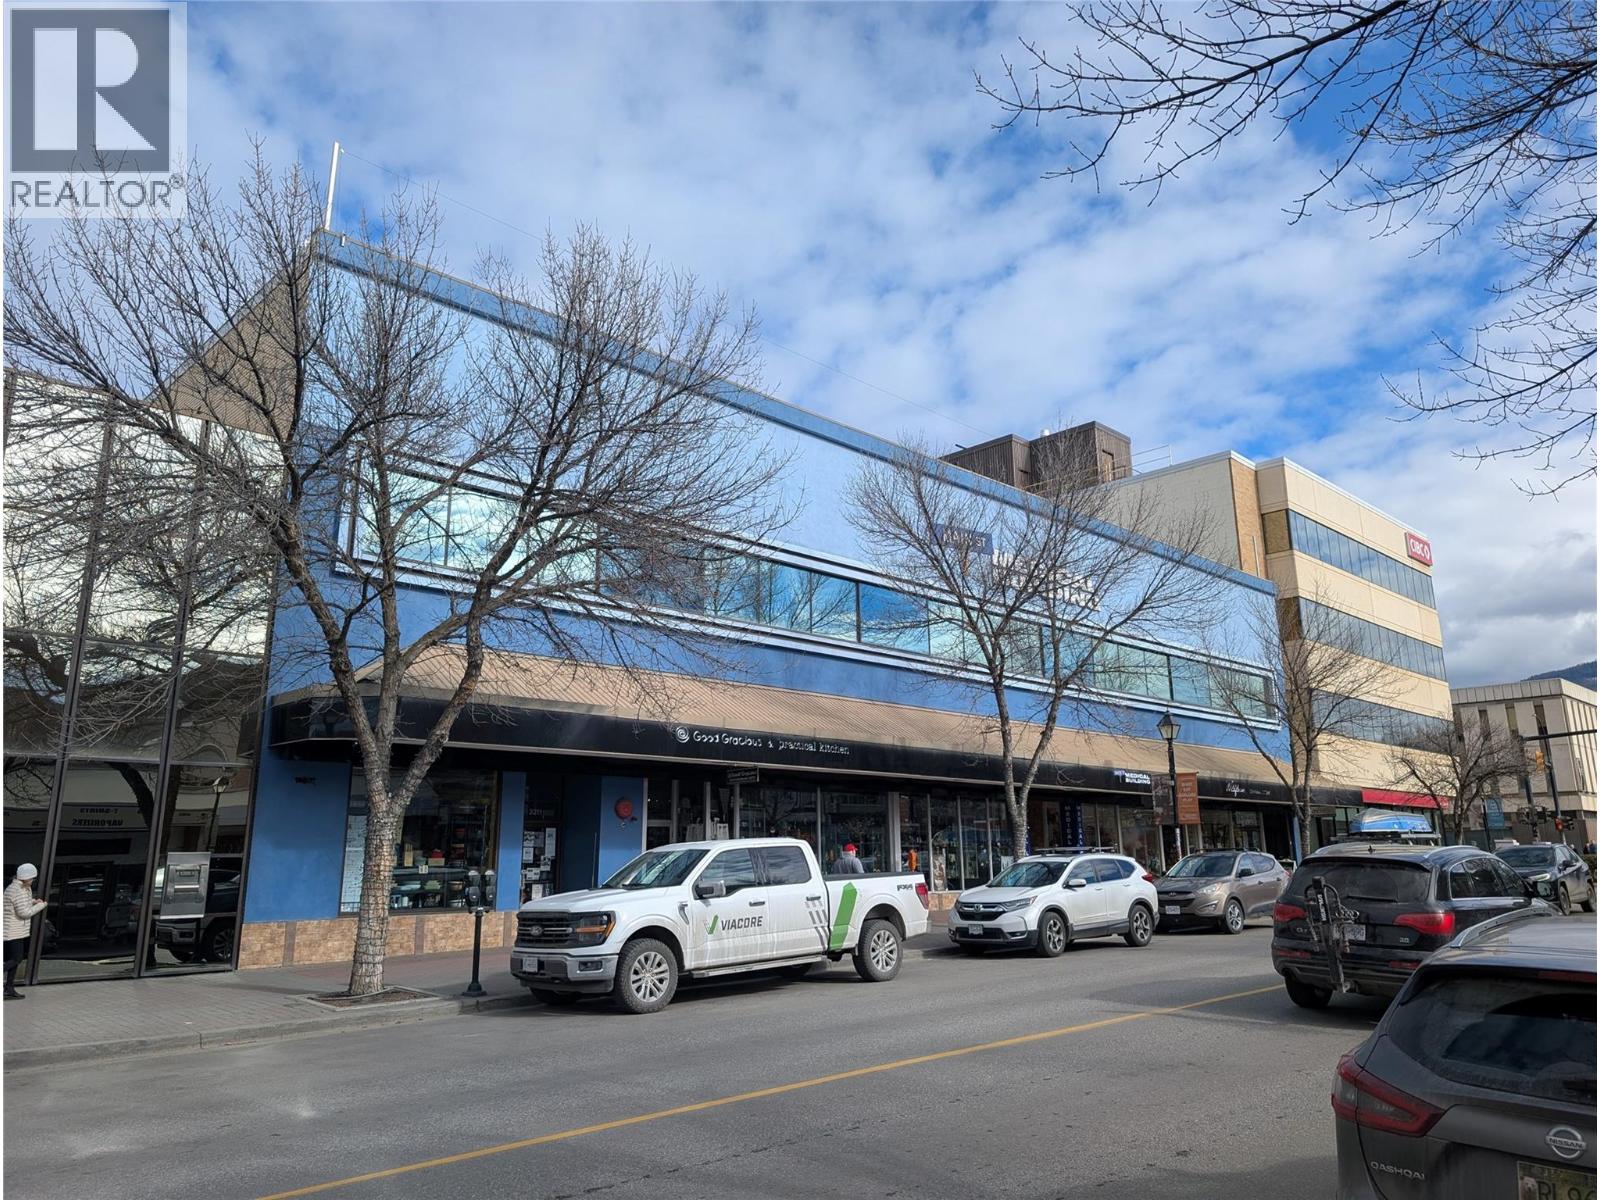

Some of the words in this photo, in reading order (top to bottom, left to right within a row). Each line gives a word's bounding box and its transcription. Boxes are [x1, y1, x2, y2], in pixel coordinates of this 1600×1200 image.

[693, 730, 719, 743] Good
[721, 733, 763, 747] Gracious
[819, 742, 850, 755] kitchen
[1125, 772, 1150, 780] MEDICAL
[721, 915, 763, 931] VIACORE
[1549, 1137, 1583, 1149] NISSAN
